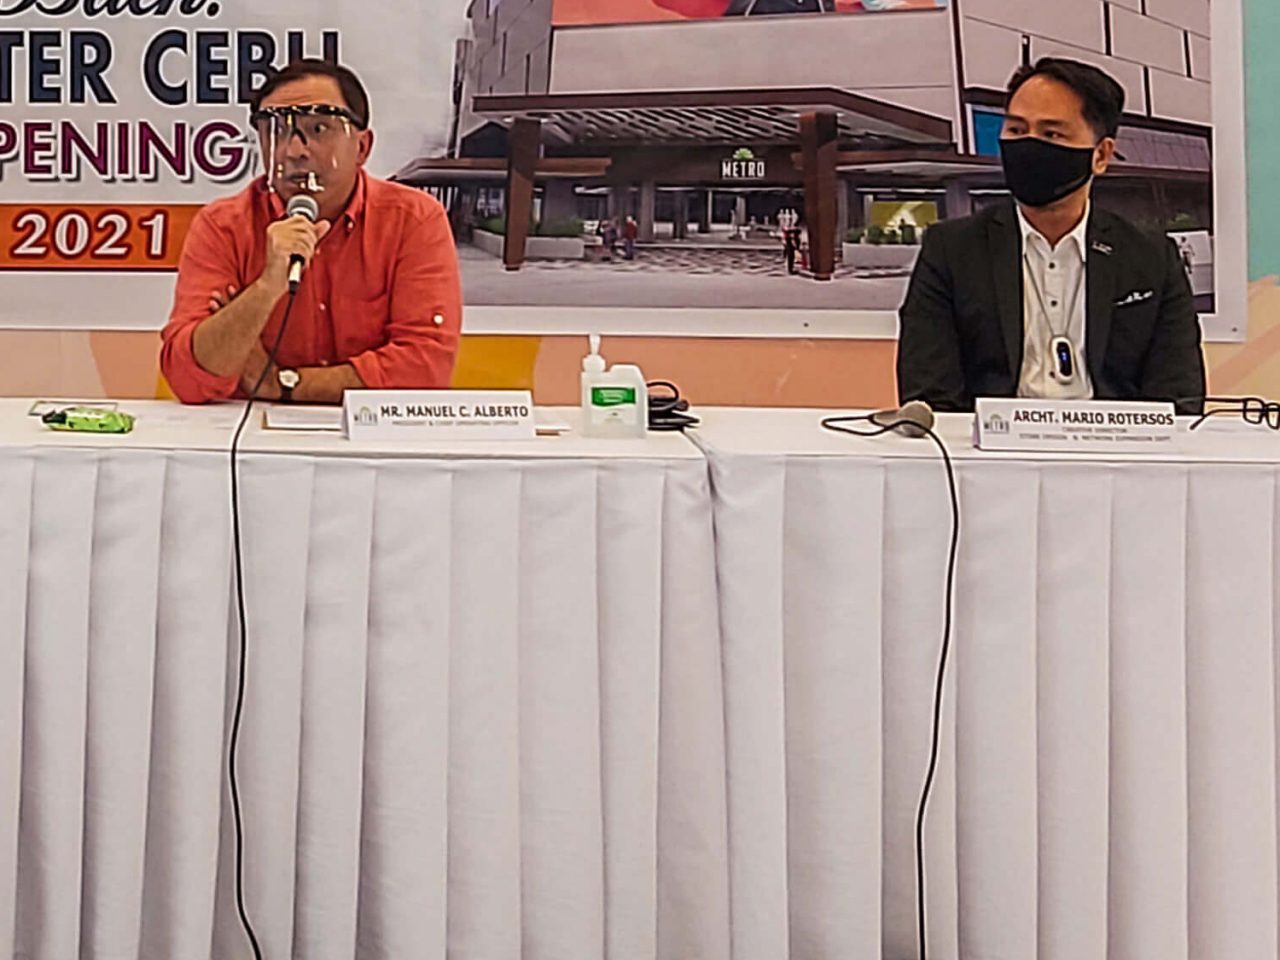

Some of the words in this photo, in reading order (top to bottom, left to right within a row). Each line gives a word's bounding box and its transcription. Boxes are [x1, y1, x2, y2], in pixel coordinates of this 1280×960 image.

[721, 161, 765, 177] METRO
[12, 211, 166, 256] 2021
[380, 405, 403, 418] MR.
[406, 405, 456, 418] MANUEL
[459, 405, 471, 418] C.
[474, 405, 529, 418] ALBERTO
[1013, 410, 1060, 424] ARCHT.
[1062, 411, 1105, 425] MARIO
[1107, 412, 1175, 426] ROTERSOS
